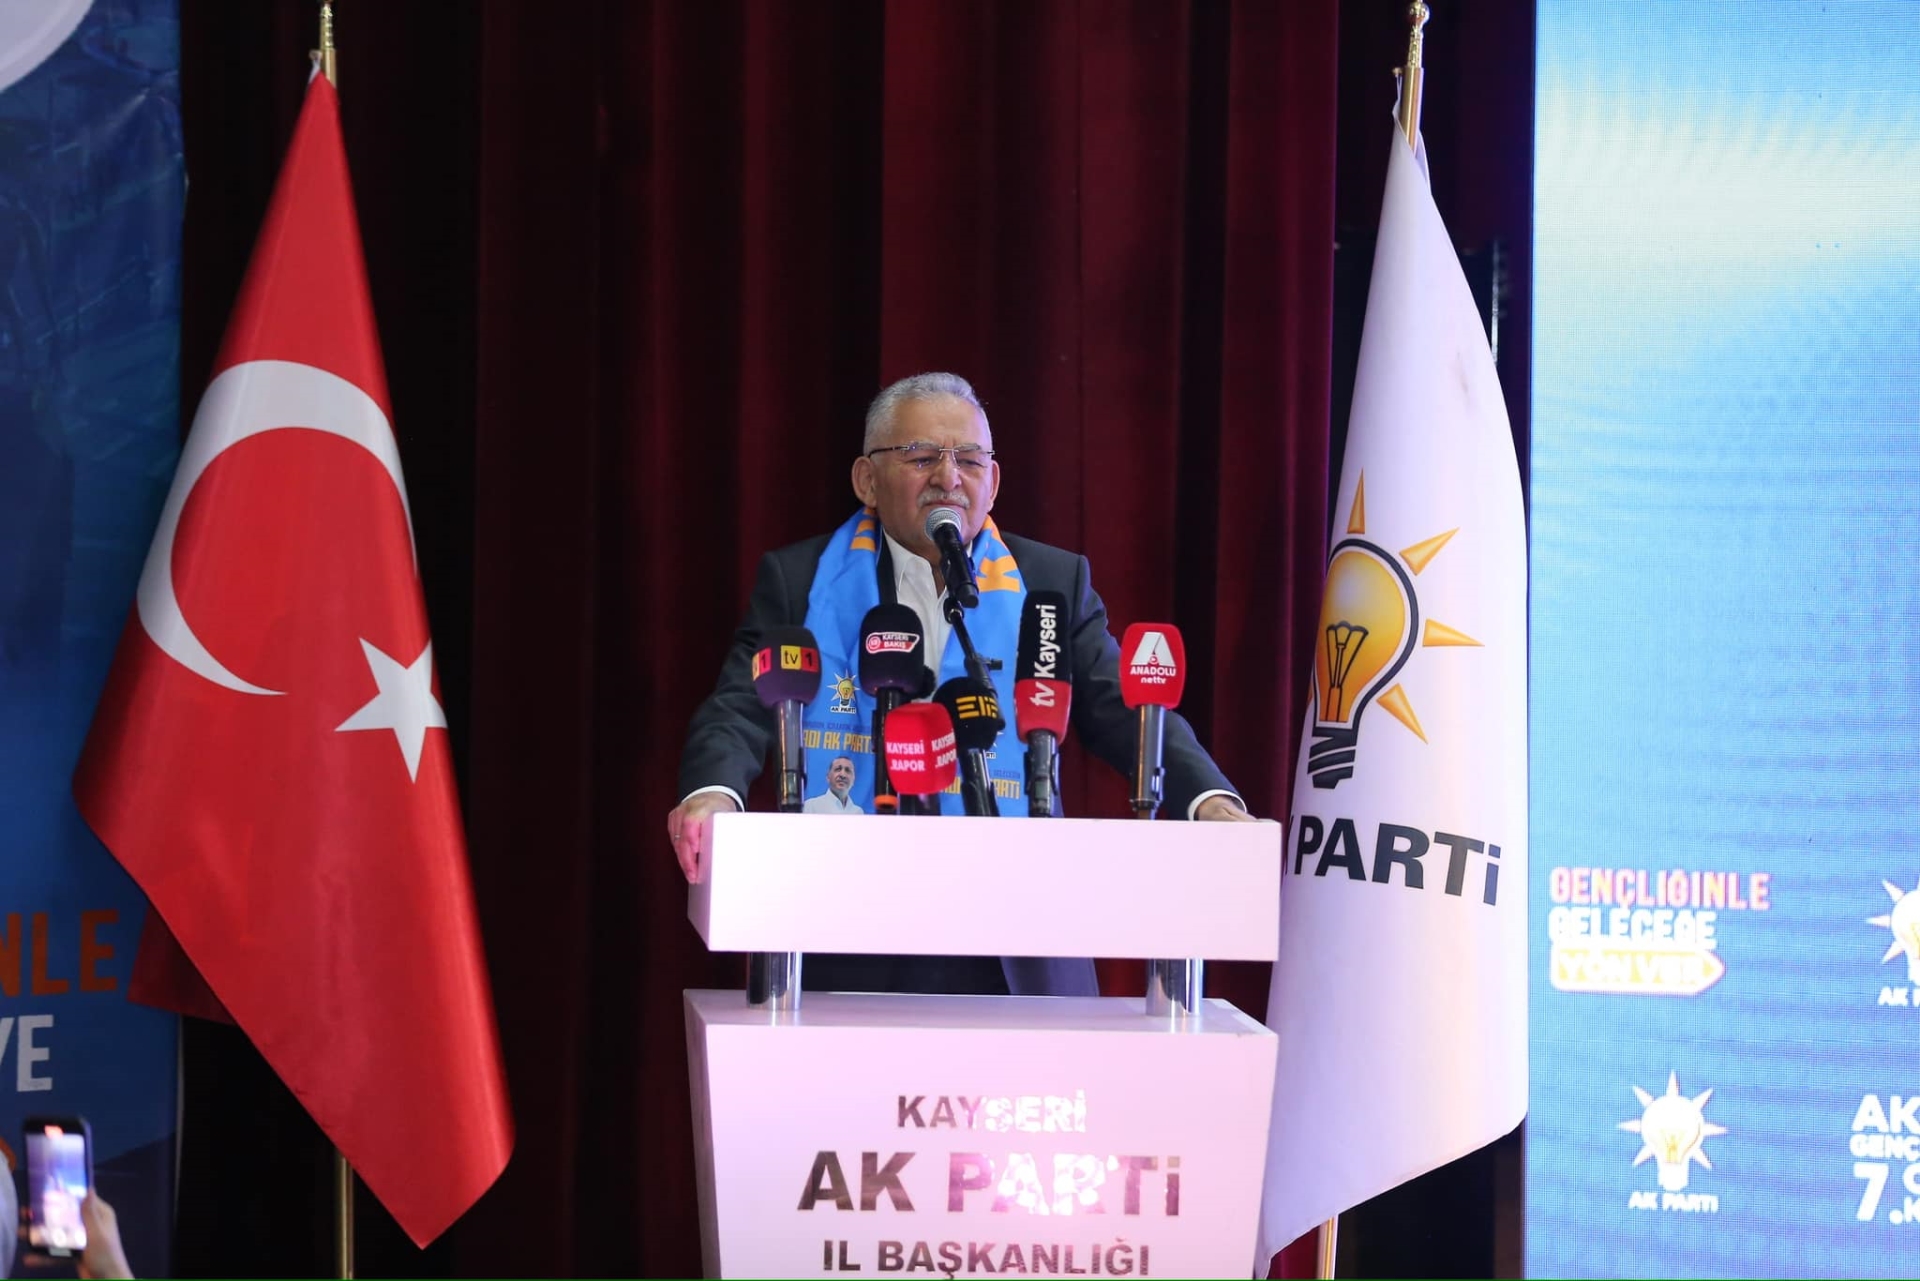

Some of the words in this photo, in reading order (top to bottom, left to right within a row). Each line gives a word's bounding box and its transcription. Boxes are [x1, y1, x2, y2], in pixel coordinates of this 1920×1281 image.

[1033, 604, 1061, 678] Kayseri
[1130, 666, 1176, 677] ANADOLU
[1029, 681, 1055, 707] tv
[886, 739, 925, 755] KAYSERİ
[897, 1088, 1086, 1133] KAYSERİ
[1851, 1094, 1920, 1136] AK
[797, 1151, 917, 1212] AK
[877, 1237, 1151, 1280] BAŞKANLIĞI
